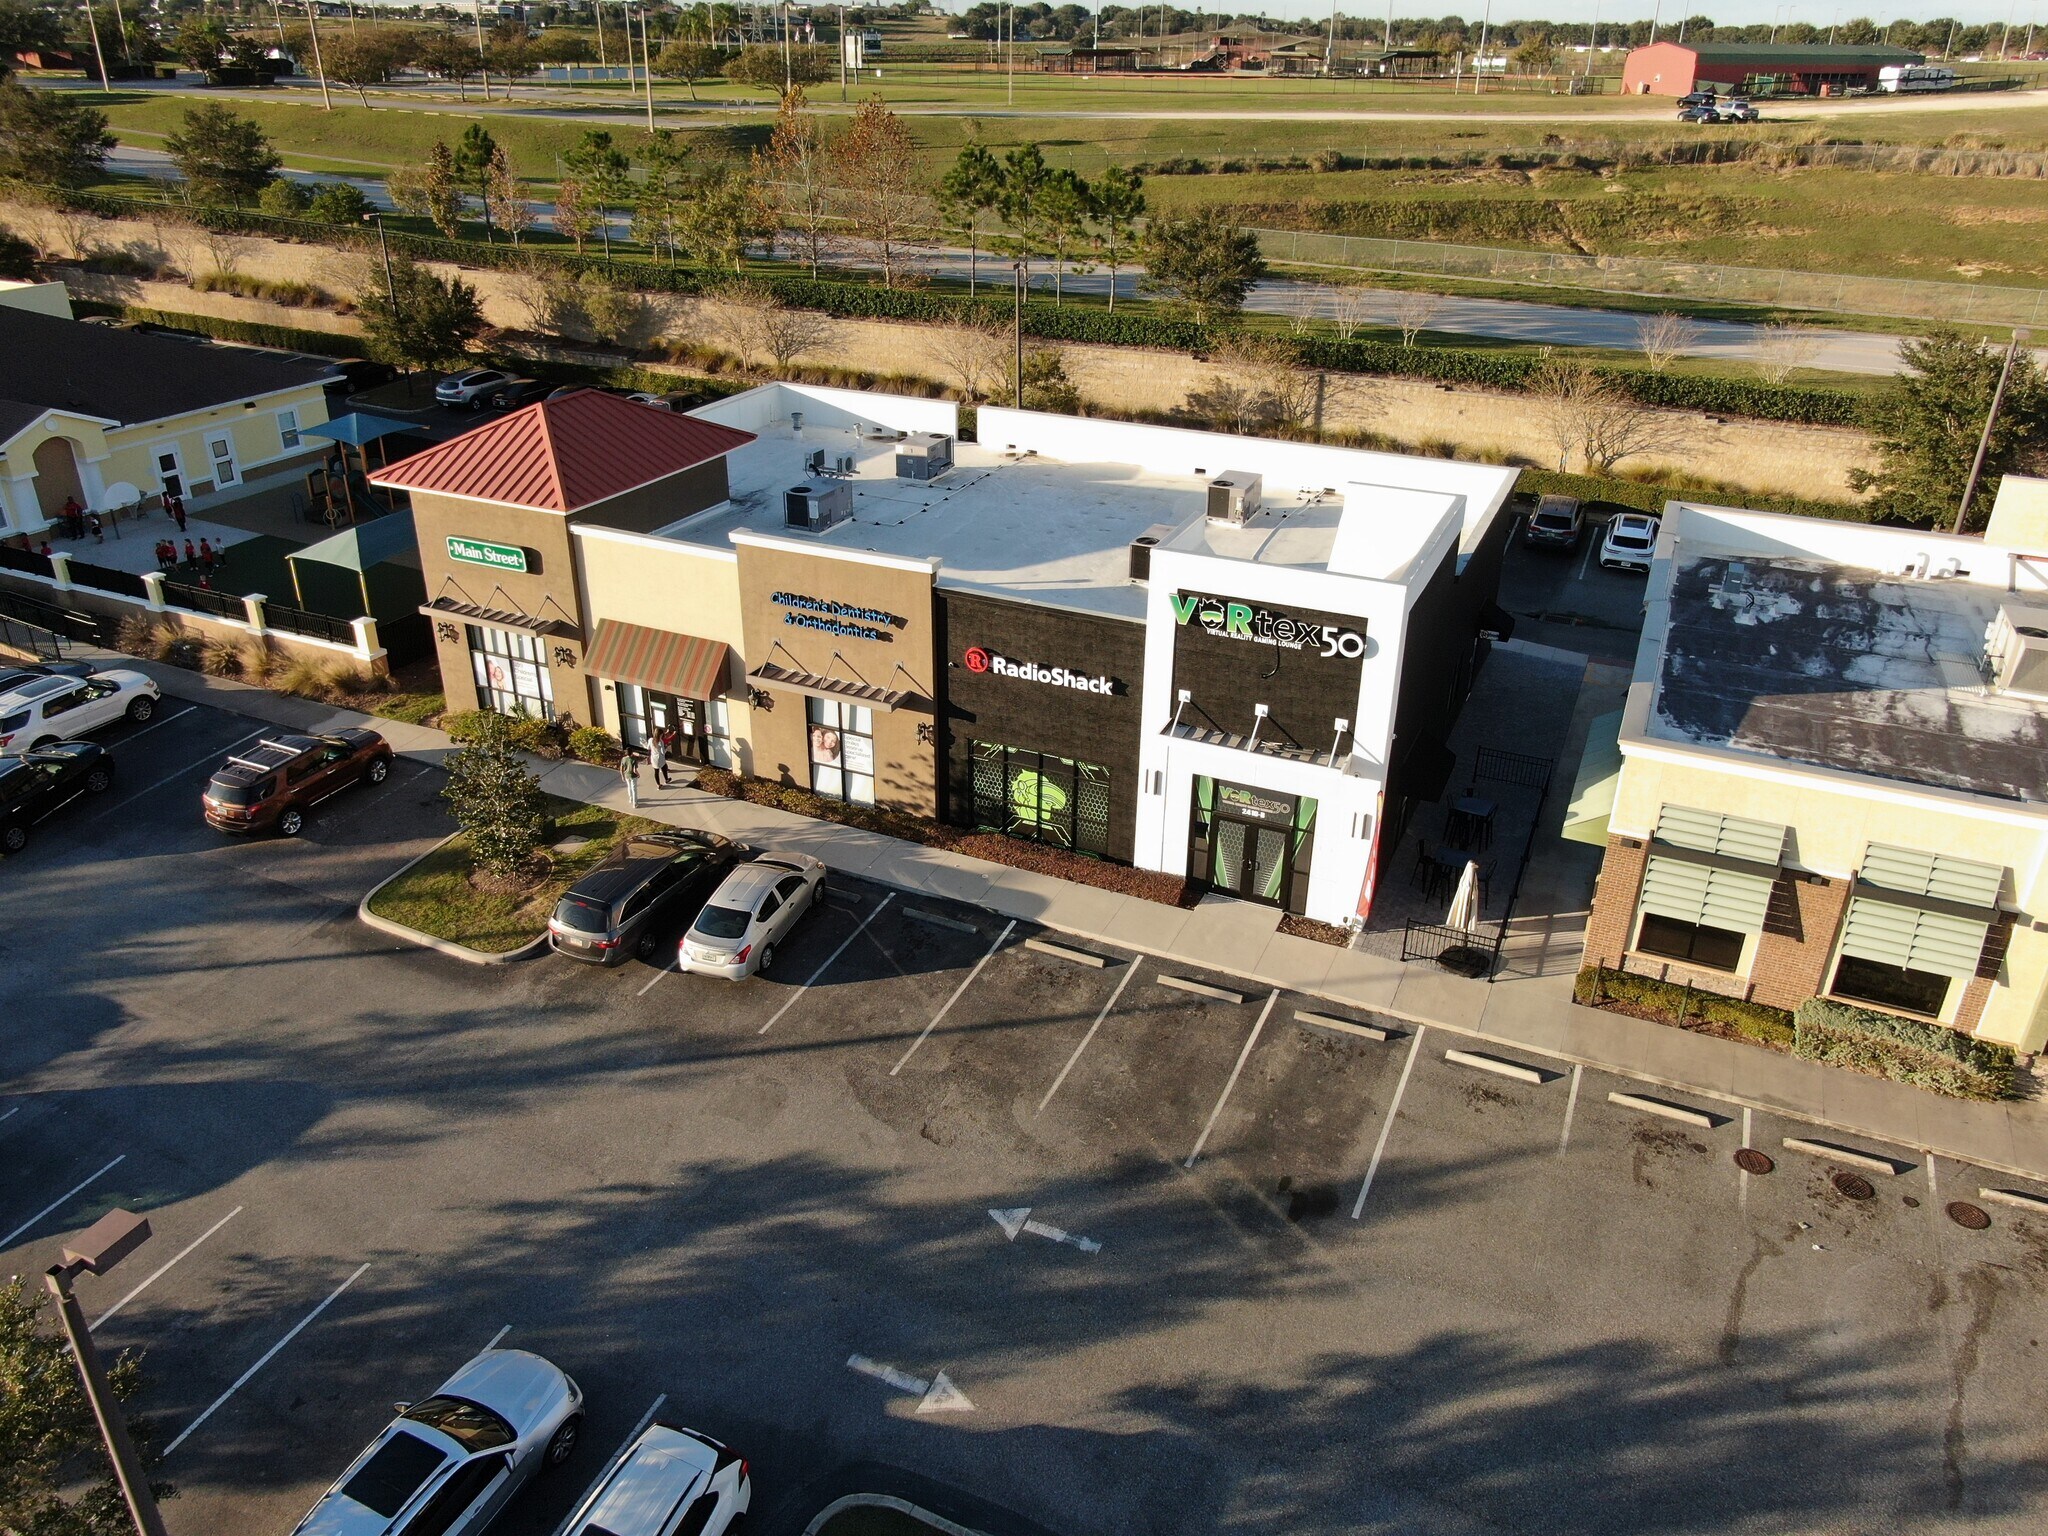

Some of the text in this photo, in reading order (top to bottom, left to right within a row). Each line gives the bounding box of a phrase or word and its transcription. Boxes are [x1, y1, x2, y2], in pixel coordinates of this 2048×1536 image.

[453, 542, 520, 567] Main Street
[770, 591, 891, 628] Children's Dentistry
[783, 612, 877, 640] & Orthodontics
[1206, 628, 1302, 650] VIRTUAL REALITY GAMING LOUNGE
[992, 656, 1113, 695] RadioShack
